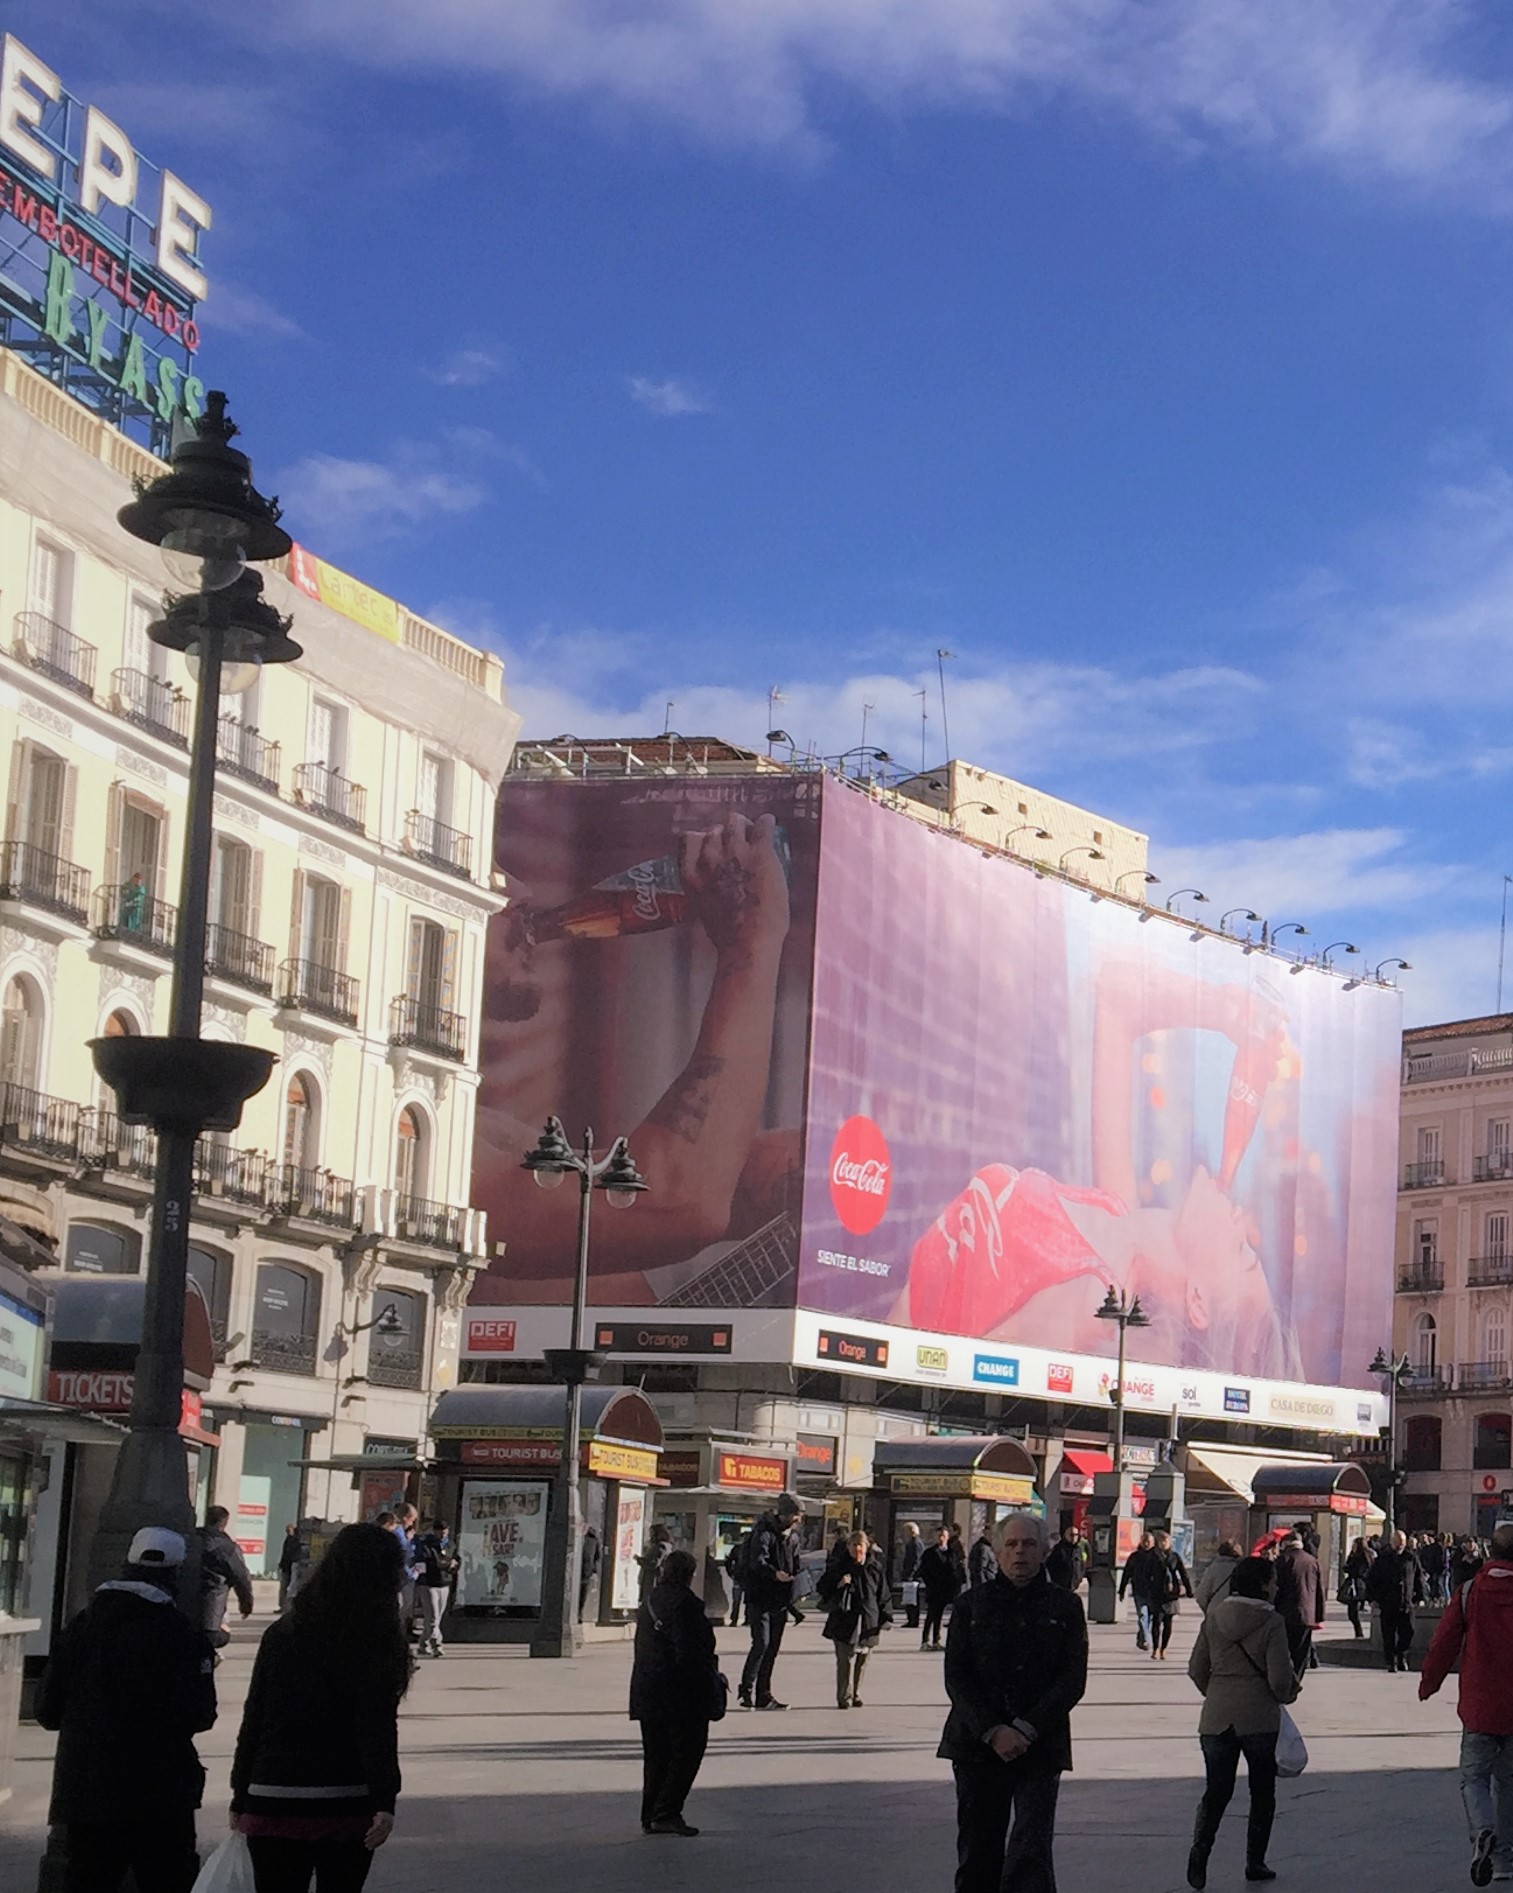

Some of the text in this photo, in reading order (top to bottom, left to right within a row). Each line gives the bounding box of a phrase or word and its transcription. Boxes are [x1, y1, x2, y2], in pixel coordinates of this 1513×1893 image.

[45, 249, 204, 427] BYASS
[833, 1151, 889, 1195] Coca-Cola
[817, 1249, 889, 1277] SIENTE EL SABOR
[470, 1322, 514, 1337] DEFI
[637, 1331, 689, 1349] Orange
[839, 1340, 866, 1360] Orange
[977, 1361, 1015, 1378] CHANGE
[1049, 1365, 1072, 1381] DEFI
[56, 1373, 135, 1405] TICKETS
[1270, 1398, 1293, 1411] CASA
[1294, 1401, 1305, 1413] DE
[491, 1447, 563, 1460] TOURIST BUS
[739, 1464, 781, 1482] TABACOS
